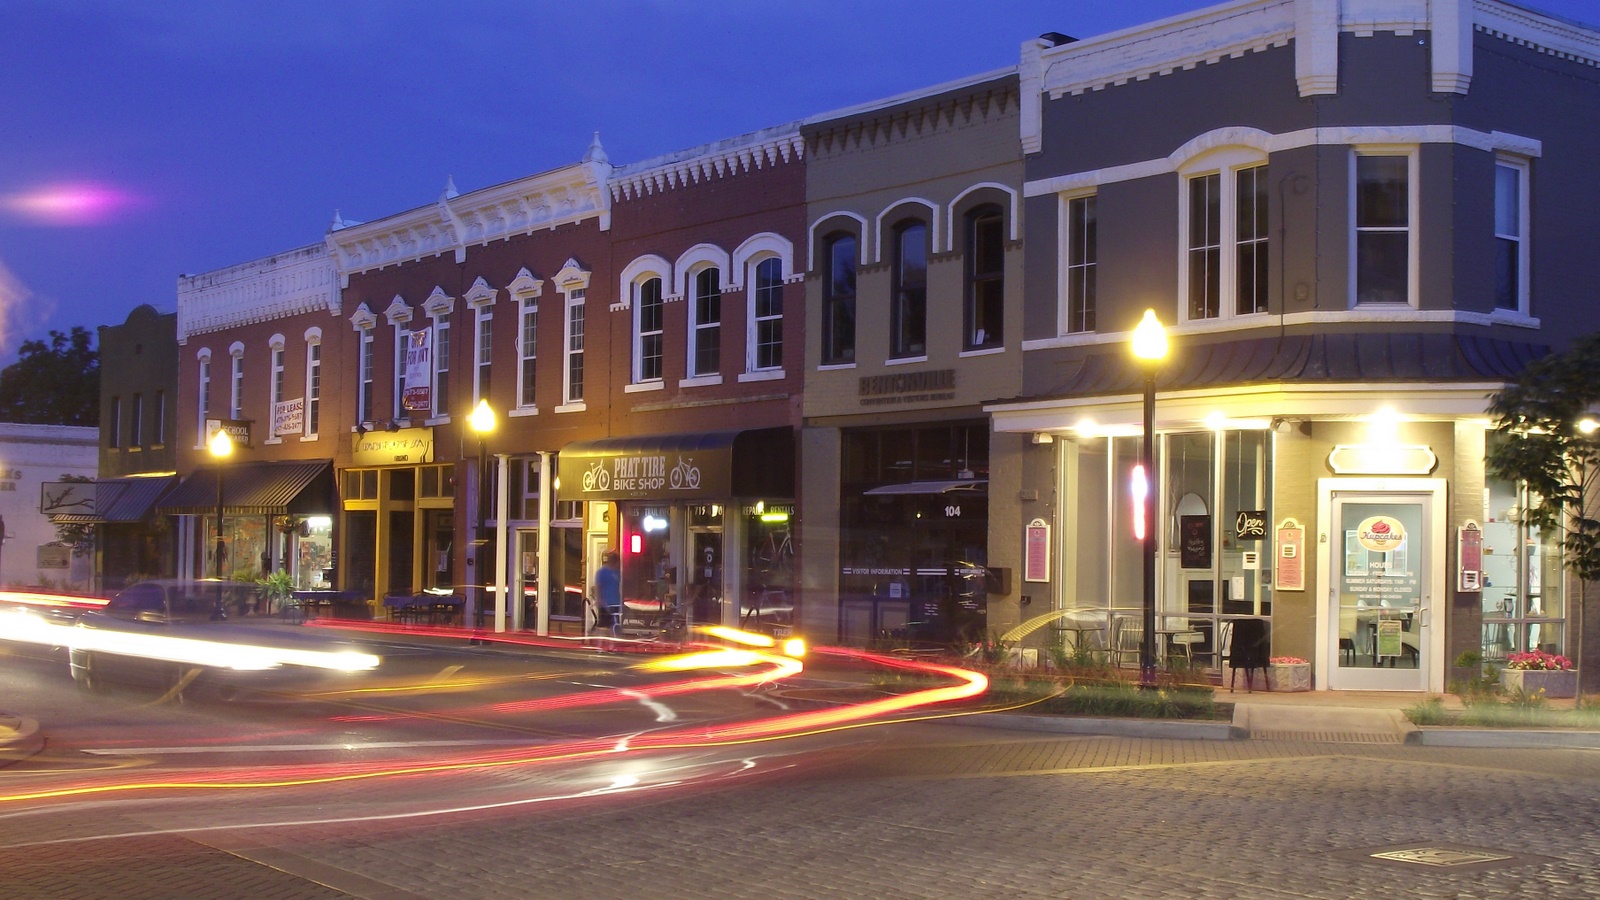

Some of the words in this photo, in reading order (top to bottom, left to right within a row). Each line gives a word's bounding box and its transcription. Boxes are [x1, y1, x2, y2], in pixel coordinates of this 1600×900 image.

[859, 369, 956, 395] BENTONVILLE
[224, 426, 249, 436] SCHOOL
[614, 457, 641, 479] PHAT
[641, 455, 666, 478] TIRE
[613, 478, 636, 491] BIKE
[638, 477, 665, 490] SHOP
[742, 505, 765, 516] REPAIS
[945, 505, 961, 517] 104
[1236, 512, 1266, 536] Open
[1361, 532, 1403, 542] Kupcakes
